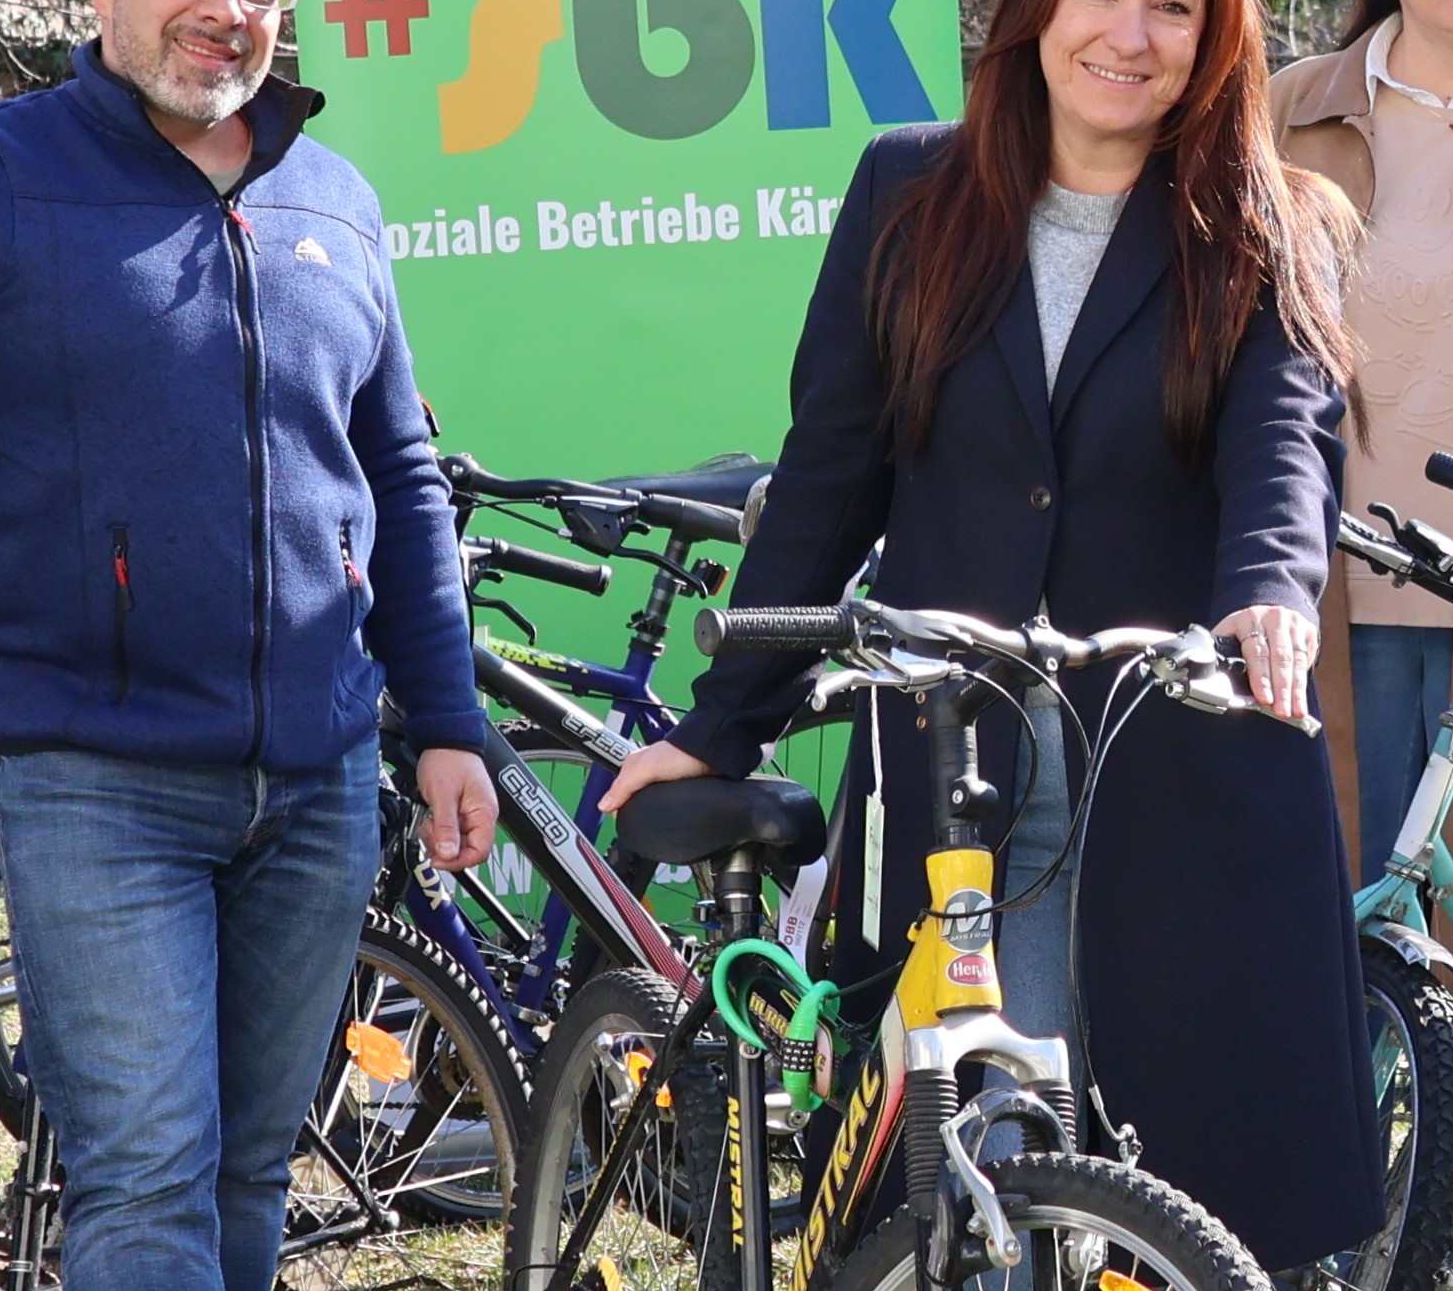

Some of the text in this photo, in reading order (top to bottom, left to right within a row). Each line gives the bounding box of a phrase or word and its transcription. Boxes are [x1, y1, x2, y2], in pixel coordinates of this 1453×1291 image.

[387, 185, 845, 260] oziale Betriebe Kär
[413, 859, 451, 911] OX
[727, 1093, 746, 1253] MISTRAL
